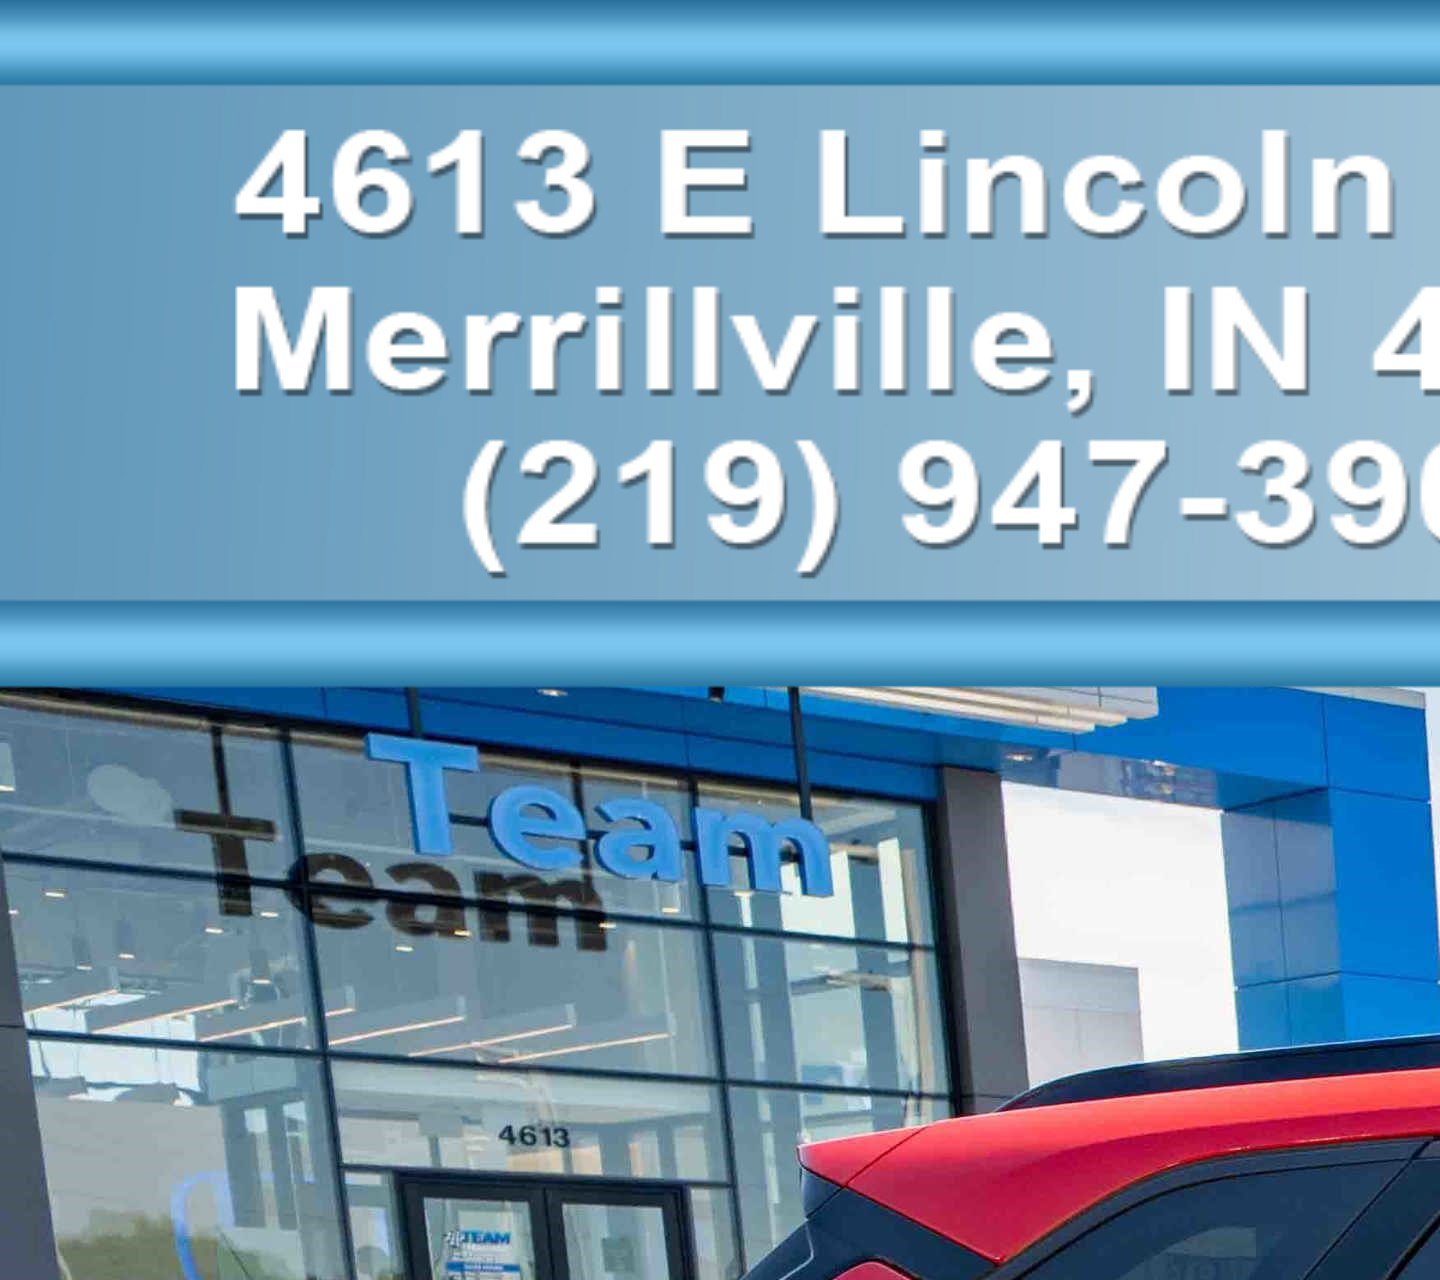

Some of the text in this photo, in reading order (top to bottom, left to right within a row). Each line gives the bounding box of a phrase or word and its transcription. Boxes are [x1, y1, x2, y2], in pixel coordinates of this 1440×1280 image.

[366, 733, 833, 897] Team
[175, 810, 607, 951] Team
[498, 1125, 570, 1148] 4613
[462, 1229, 512, 1245] TEAM
